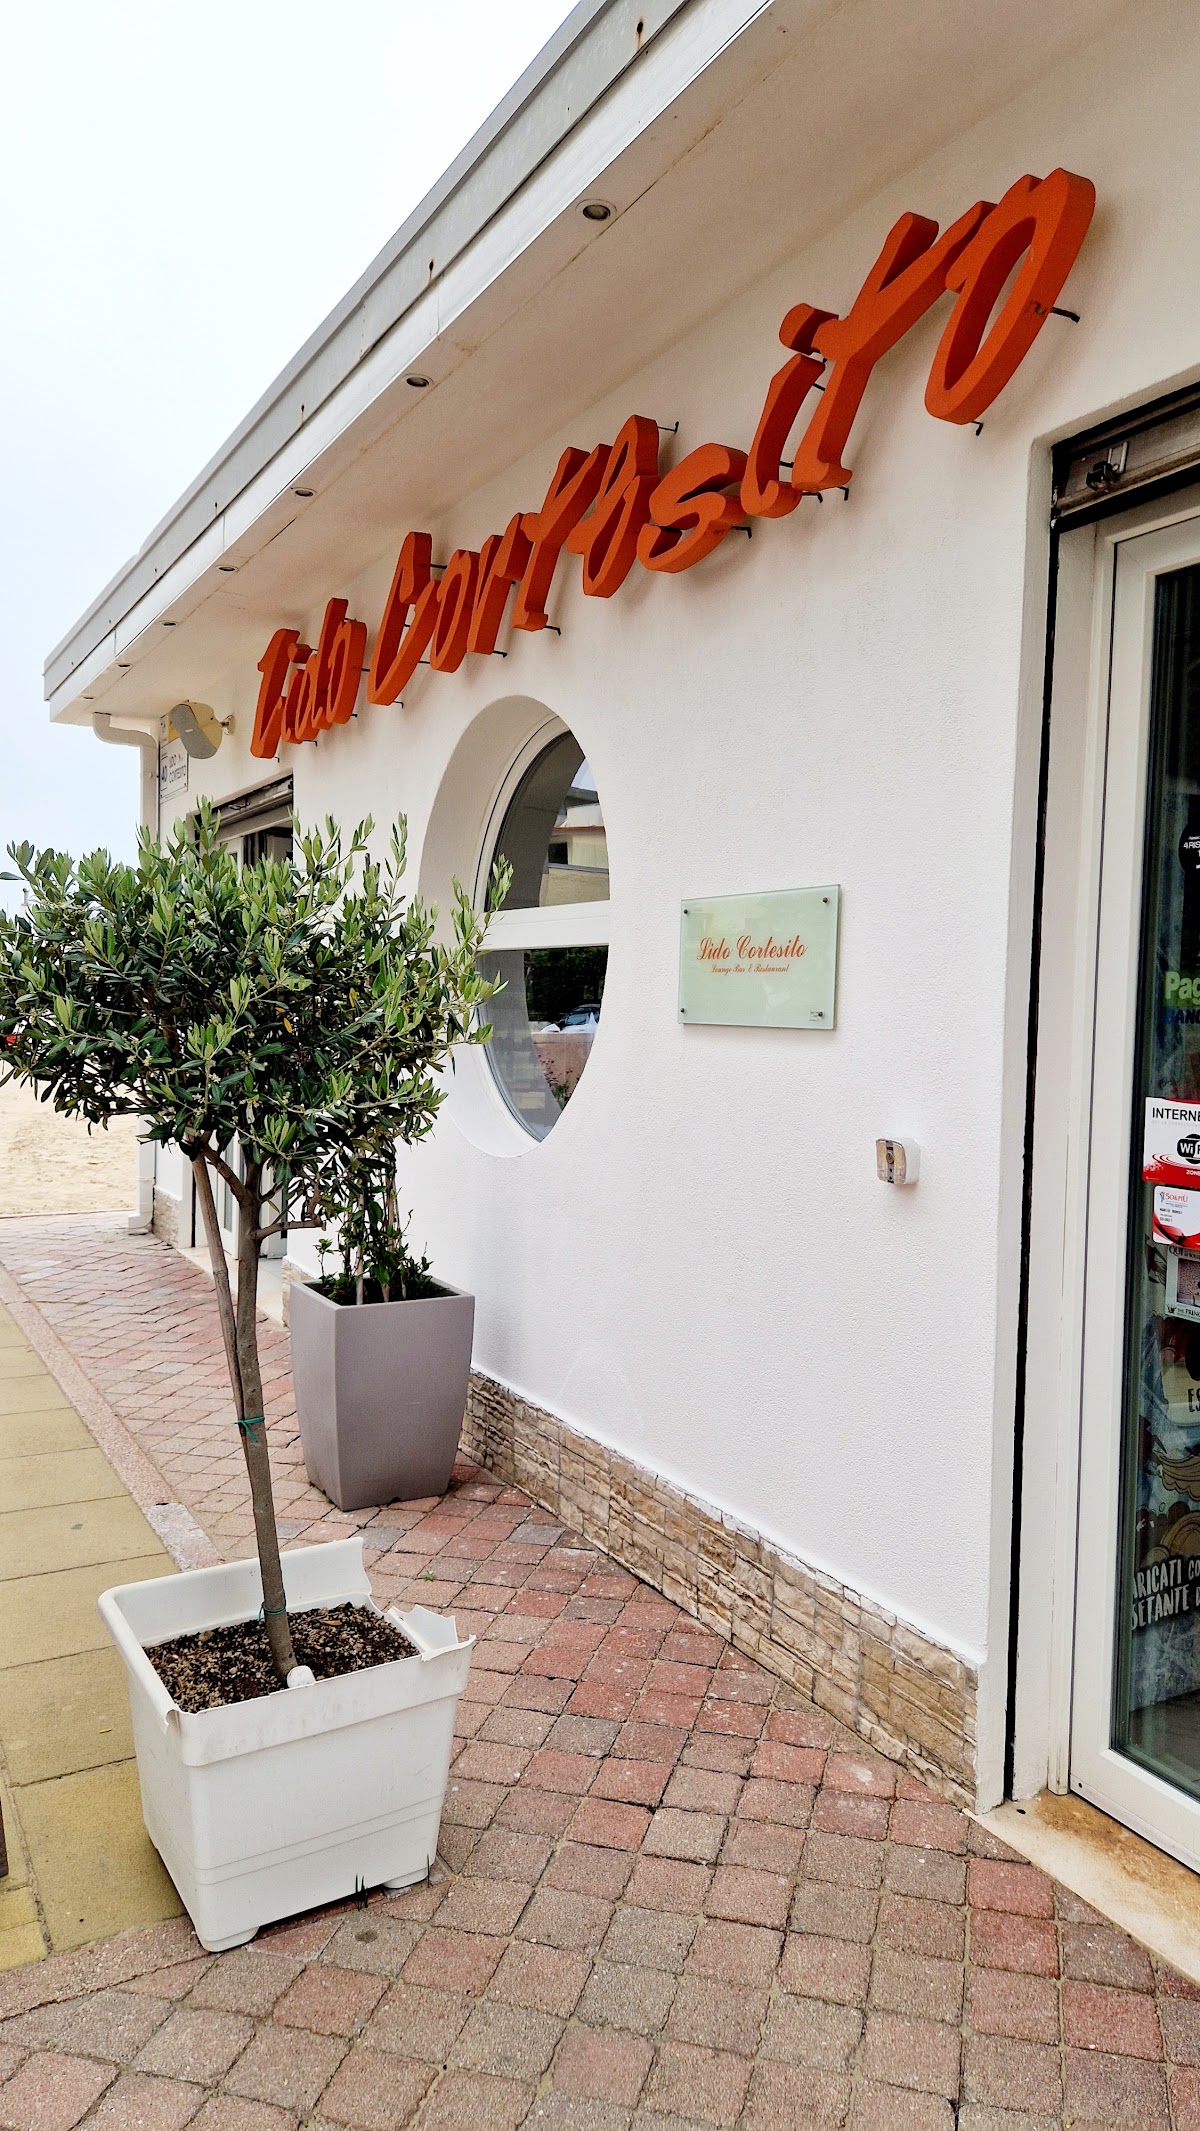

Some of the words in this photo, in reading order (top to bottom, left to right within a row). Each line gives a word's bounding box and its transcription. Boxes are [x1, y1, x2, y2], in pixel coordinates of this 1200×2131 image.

[368, 167, 1096, 705] Cortesito
[697, 937, 732, 961] Lido
[736, 935, 808, 959] Cortesito
[753, 963, 790, 973] Restaurant
